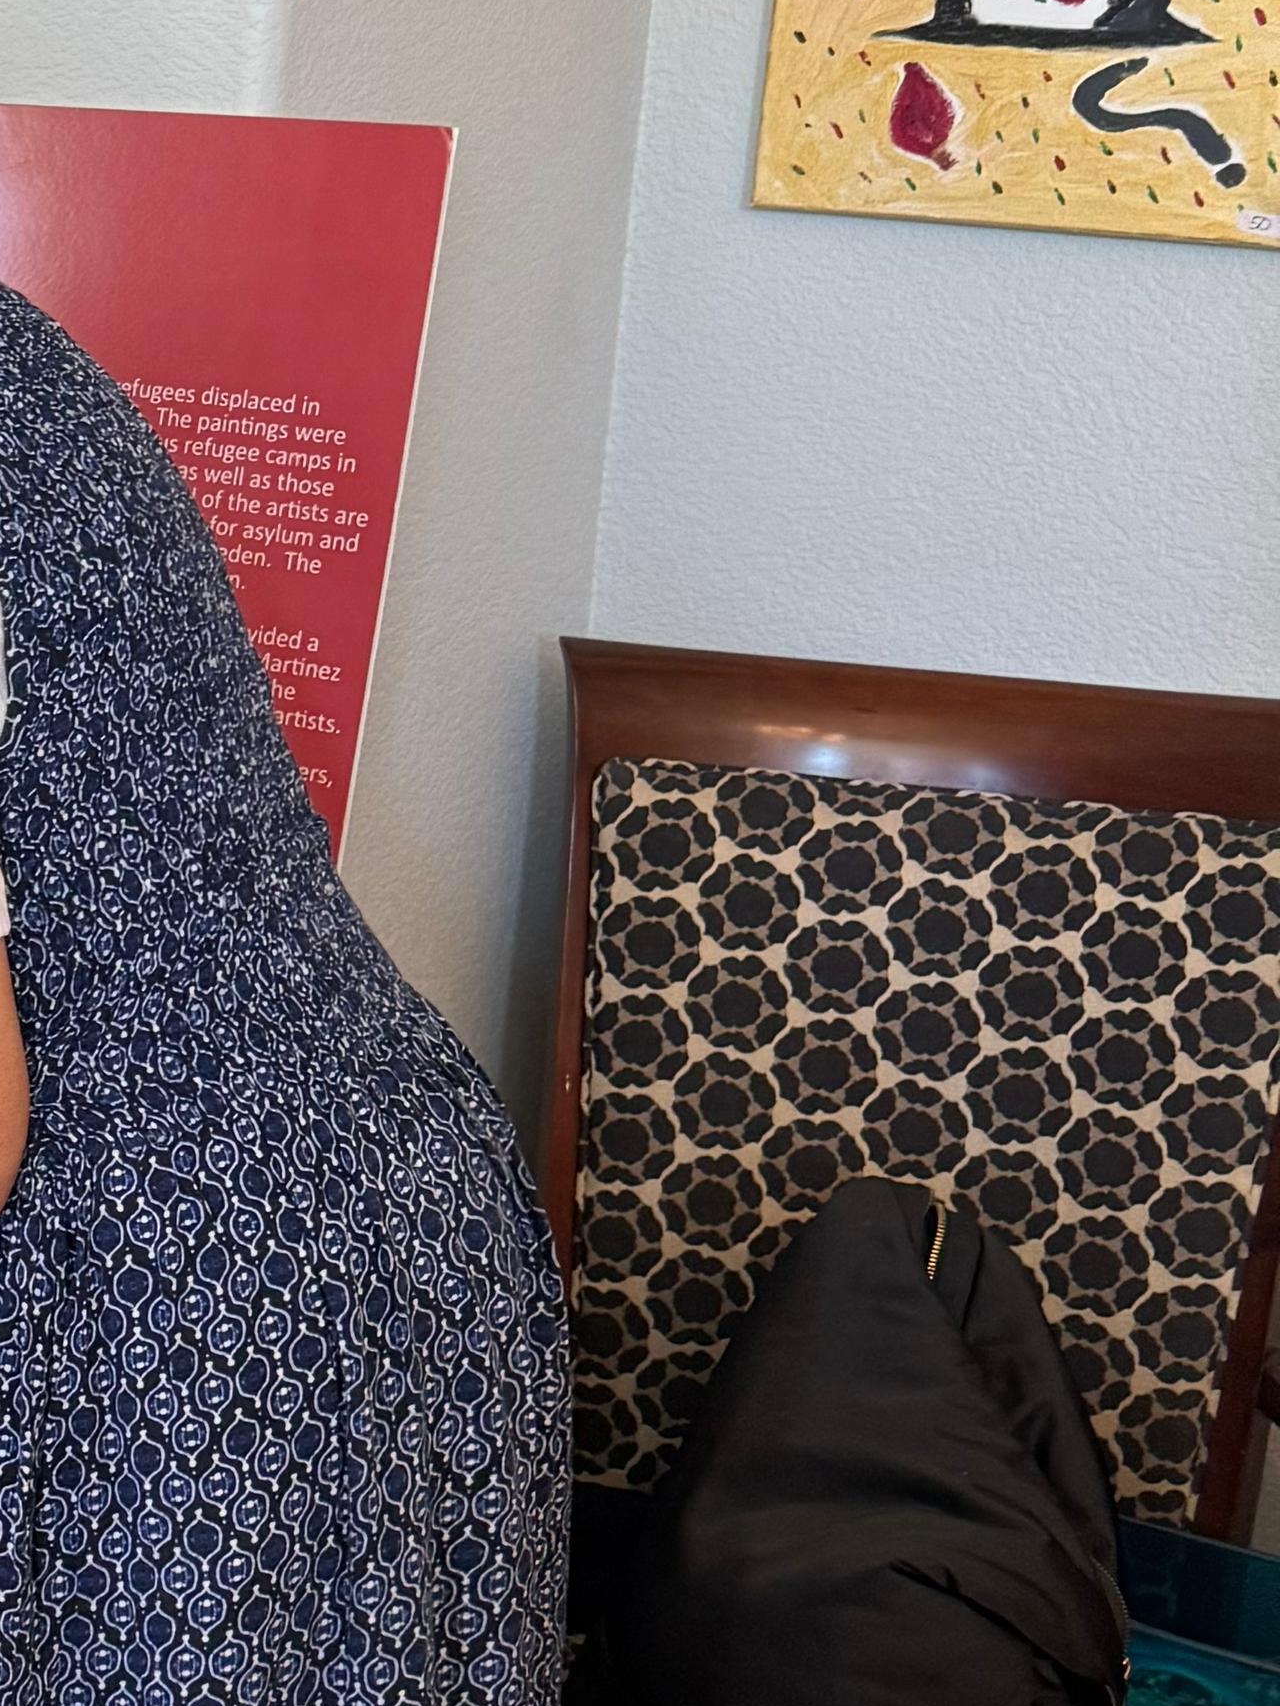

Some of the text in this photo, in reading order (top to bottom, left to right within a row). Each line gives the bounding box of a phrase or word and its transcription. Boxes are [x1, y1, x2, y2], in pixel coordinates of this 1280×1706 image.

[201, 386, 296, 413] displaced
[301, 395, 320, 416] in
[156, 406, 347, 445] The paintings were
[183, 437, 260, 463] refugee
[265, 448, 331, 473] camps
[337, 452, 357, 473] in
[178, 465, 335, 497] as well as those
[201, 489, 222, 509] of
[227, 493, 261, 514] the
[265, 501, 329, 523] artists
[334, 510, 369, 528] are
[209, 516, 361, 553] for asylum and
[220, 544, 322, 575] eden. The
[247, 624, 319, 652] vided a
[271, 678, 296, 701] he
[274, 708, 341, 735] artists.
